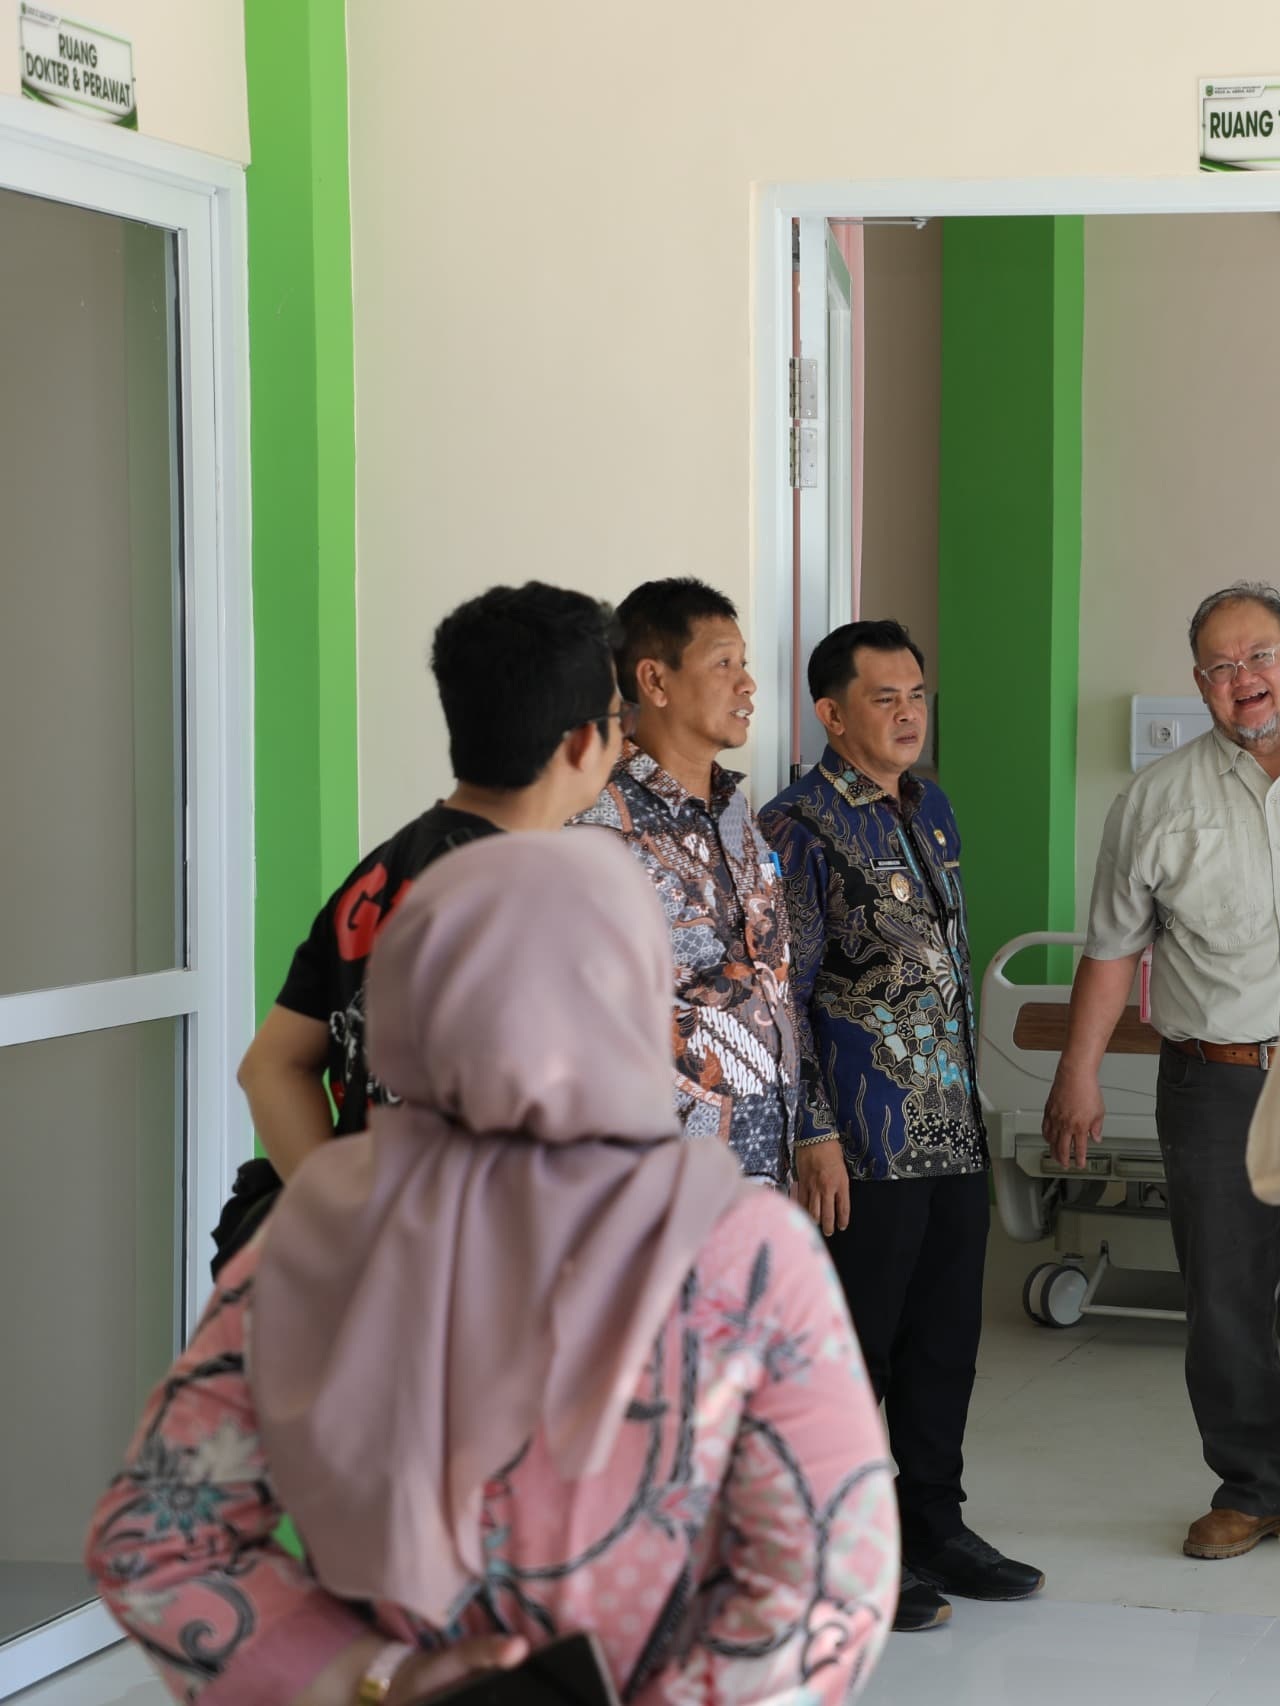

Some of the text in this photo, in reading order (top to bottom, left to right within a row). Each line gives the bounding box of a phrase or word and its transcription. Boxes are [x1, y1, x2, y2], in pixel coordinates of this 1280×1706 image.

[58, 33, 98, 69] RUANG
[25, 51, 131, 108] DOKTER & PERAWAT
[1209, 110, 1274, 139] RUANG
